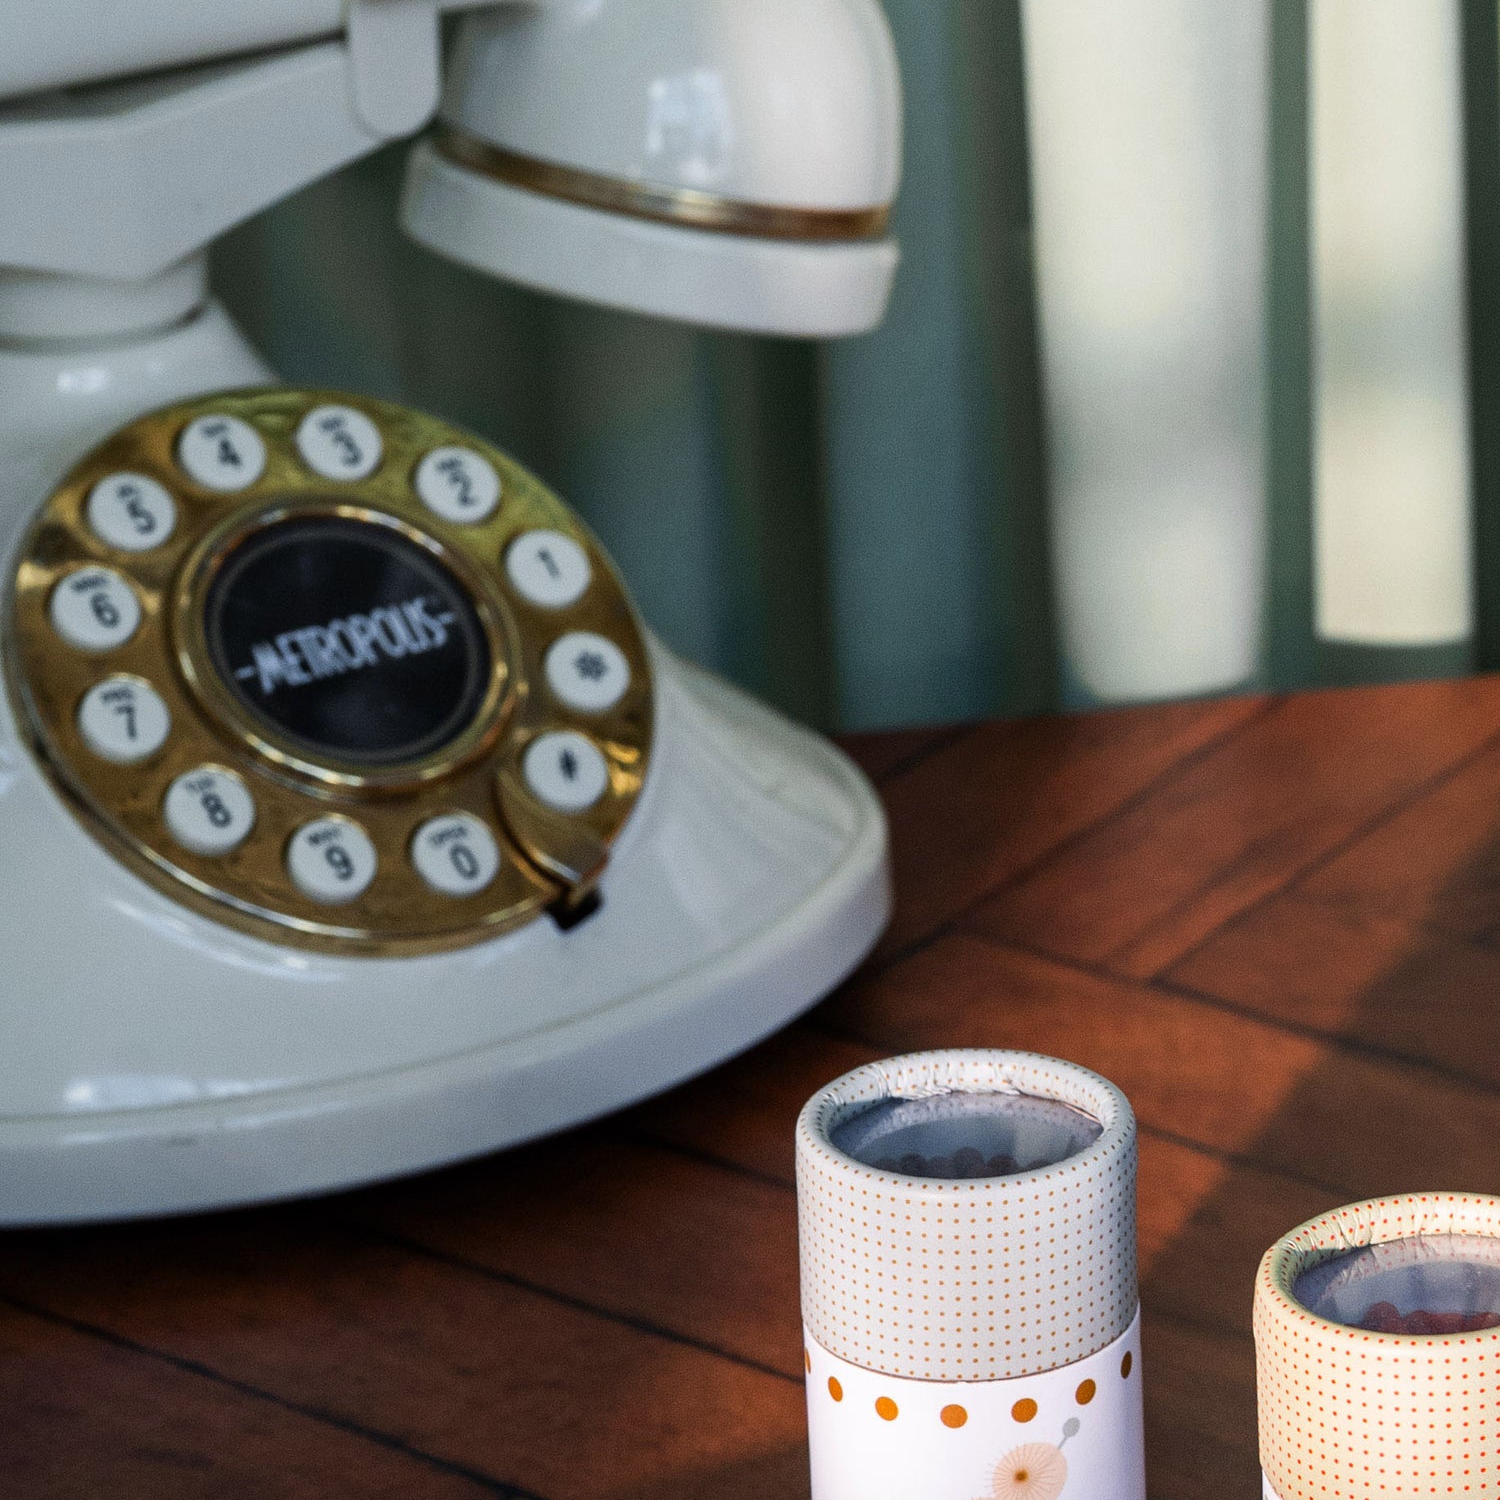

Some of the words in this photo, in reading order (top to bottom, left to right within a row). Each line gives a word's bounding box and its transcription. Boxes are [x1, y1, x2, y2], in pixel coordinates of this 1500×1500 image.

[126, 500, 157, 535] 5
[90, 592, 121, 628] 6
[115, 703, 138, 742] 7
[201, 791, 233, 829] 8
[325, 845, 355, 883] 9
